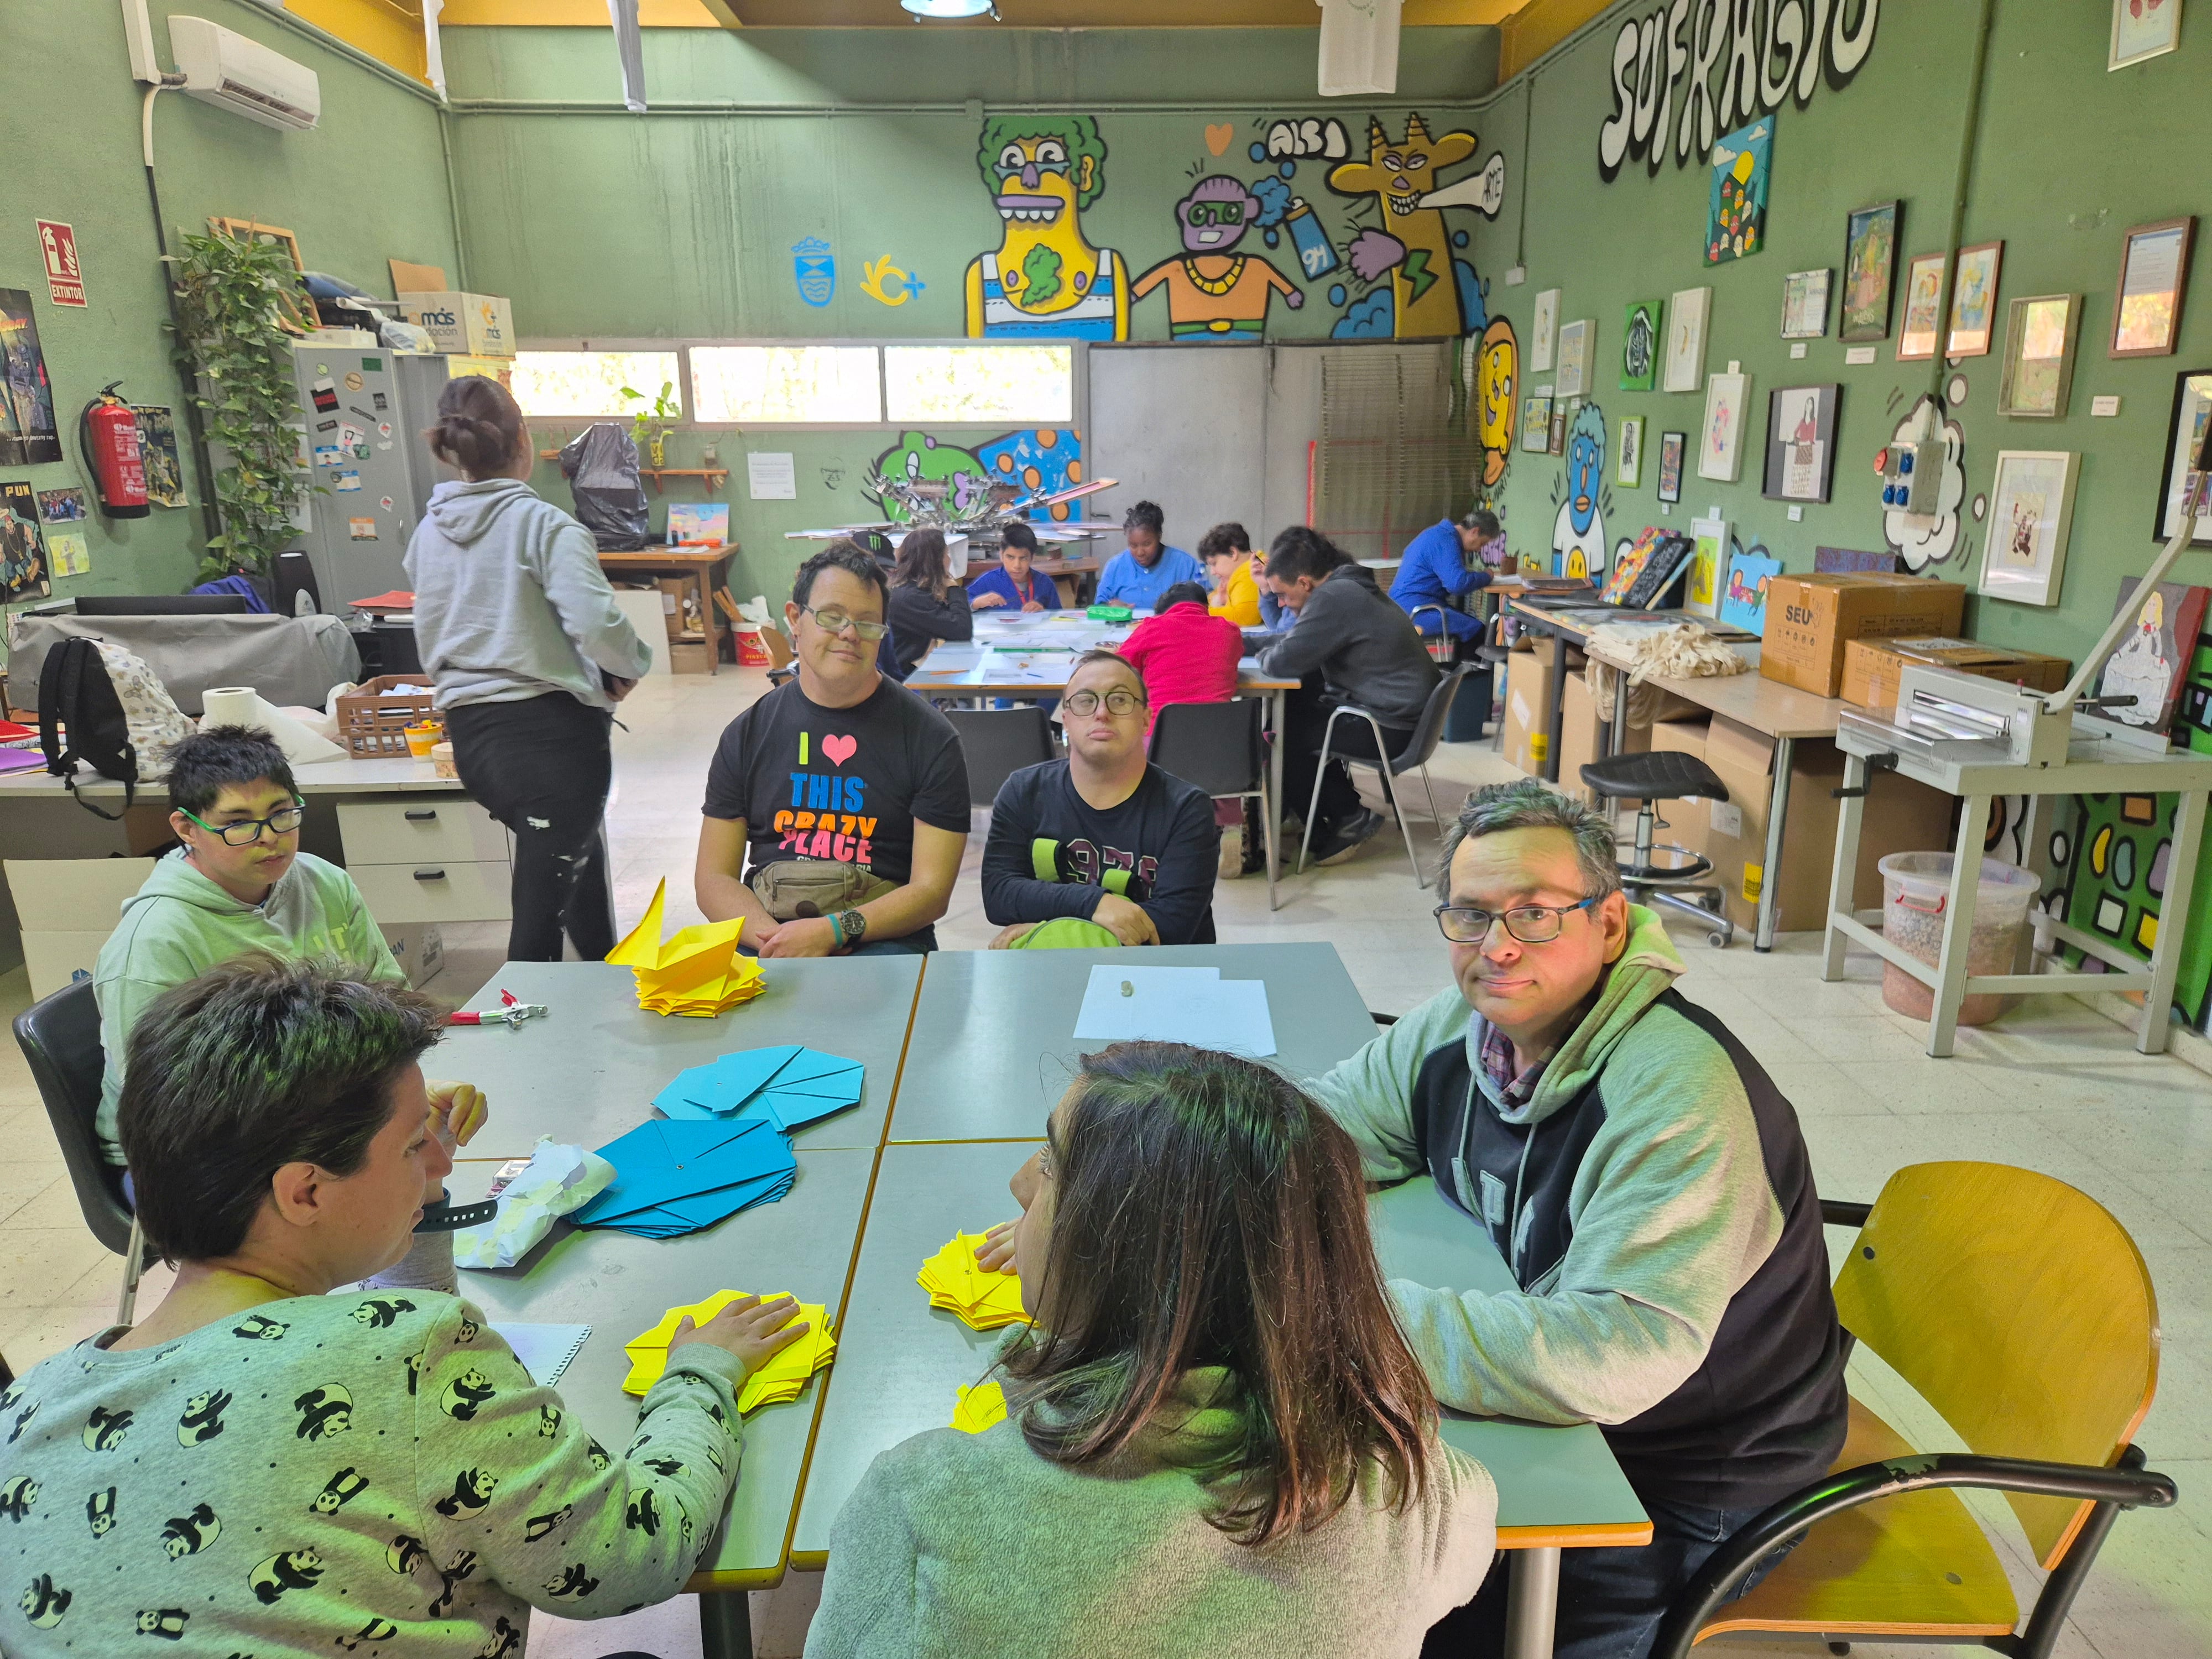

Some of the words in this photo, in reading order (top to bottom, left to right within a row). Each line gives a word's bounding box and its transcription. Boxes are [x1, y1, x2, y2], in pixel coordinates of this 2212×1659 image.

[51, 284, 84, 300] EXTINTOR
[5, 484, 30, 497] PUN
[799, 731, 808, 765] I
[790, 772, 865, 812] THIS
[774, 809, 878, 839] CRAZY
[778, 829, 873, 864] PLACE
